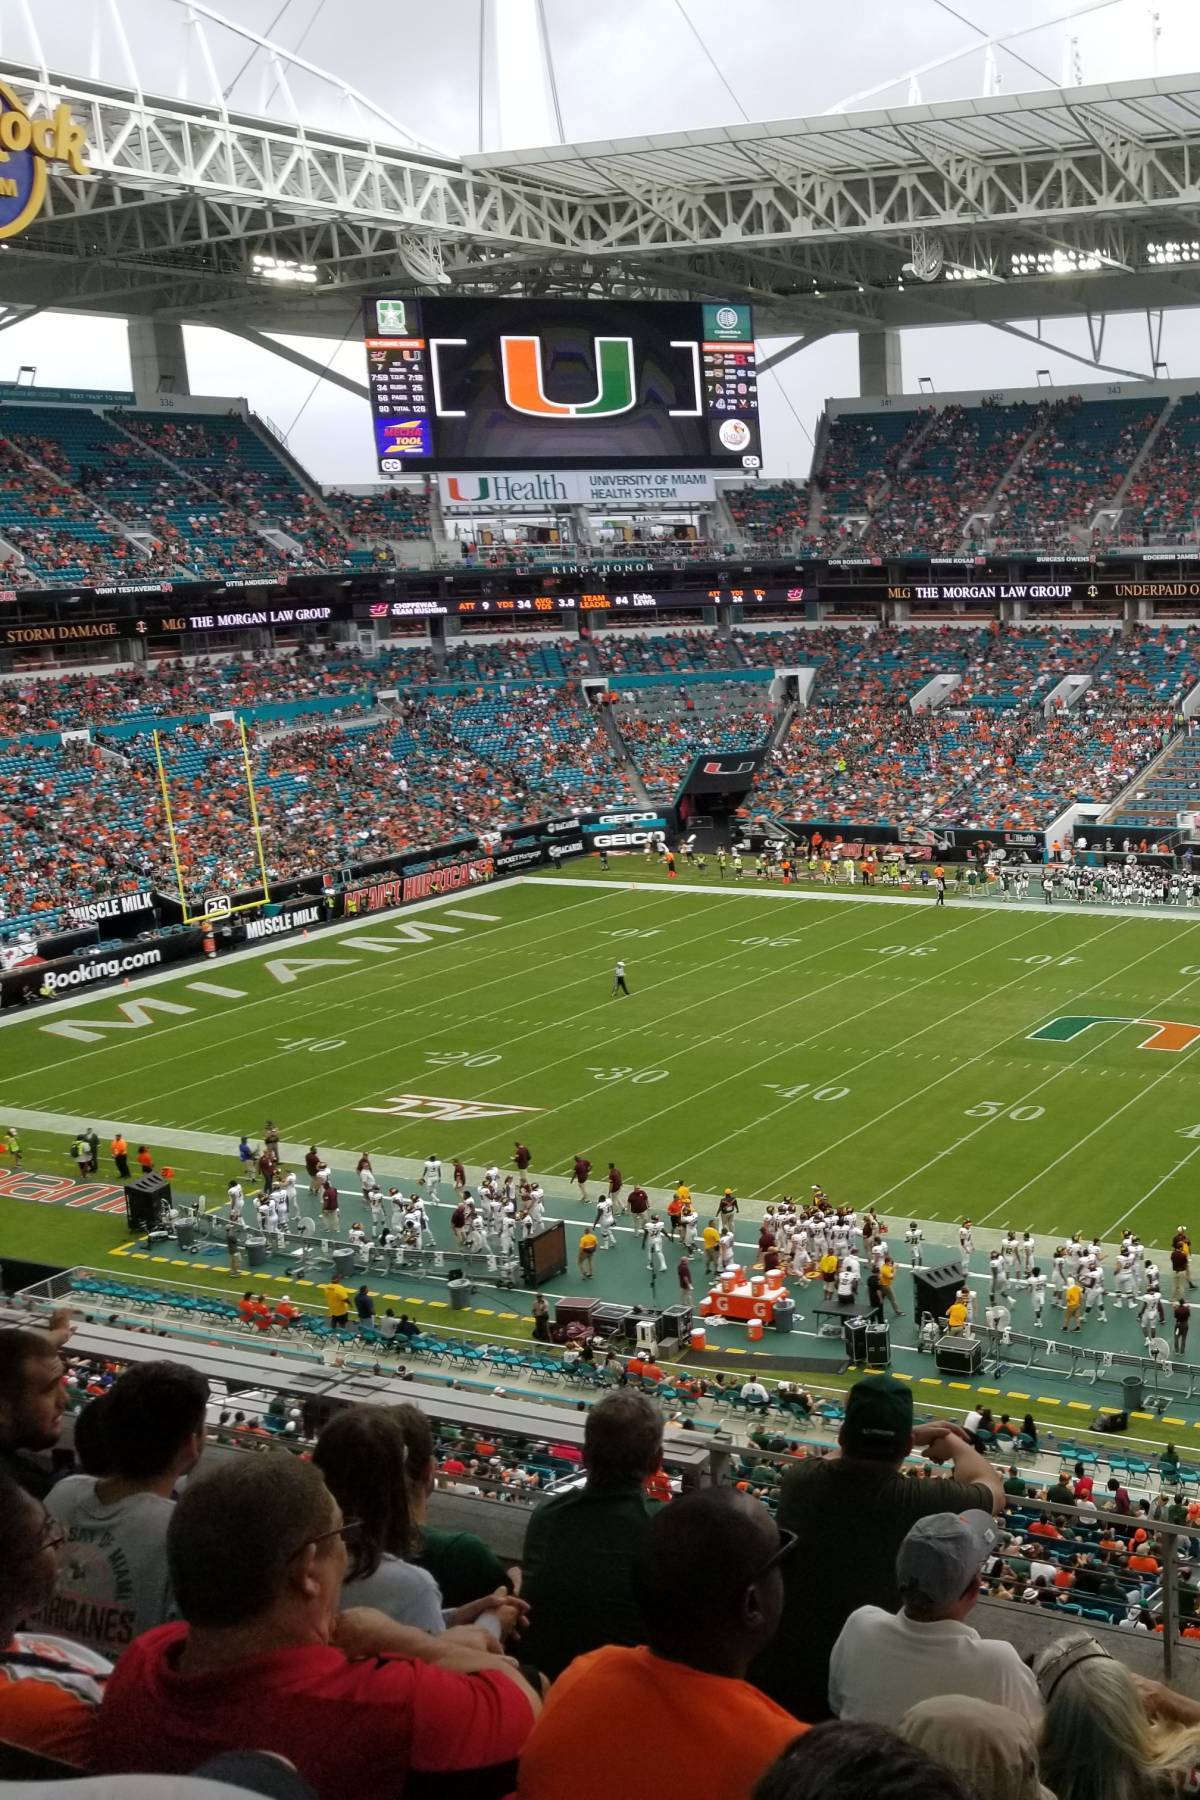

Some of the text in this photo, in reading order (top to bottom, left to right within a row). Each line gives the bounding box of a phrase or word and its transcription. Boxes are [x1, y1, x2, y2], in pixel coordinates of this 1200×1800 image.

[500, 336, 636, 418] U
[396, 437, 423, 445] TOOL
[384, 461, 398, 469] CC
[589, 474, 707, 486] UNIVERSITY OF MIAMI
[591, 488, 677, 499] HEALTH SYSTEM
[552, 564, 655, 574] RING HONOR
[245, 578, 278, 586] ANDERSON
[95, 587, 117, 595] VINNY
[888, 585, 1072, 599] MLG THE MORGAN LAW GROUP
[1115, 584, 1187, 596] UNDERPAID
[459, 602, 476, 610] ATT
[482, 602, 490, 610] 9
[517, 600, 531, 608] 34
[558, 598, 575, 607] 3.8
[163, 607, 331, 631] MLG THE MORGAN LAW GROUP
[7, 623, 121, 643] STORM DAMAGE.
[600, 812, 658, 824] GEICO
[594, 831, 666, 847] GEICO
[121, 892, 153, 914] MILK
[246, 906, 319, 938] MUSCLE MILK
[38, 909, 503, 1043] MIAMI
[44, 948, 161, 990] Booking.com
[430, 1051, 502, 1068] 20
[594, 1066, 670, 1084] 30
[773, 1084, 851, 1101] 40
[964, 1101, 1045, 1121] 50
[716, 1297, 728, 1311] G
[753, 1303, 766, 1317] G
